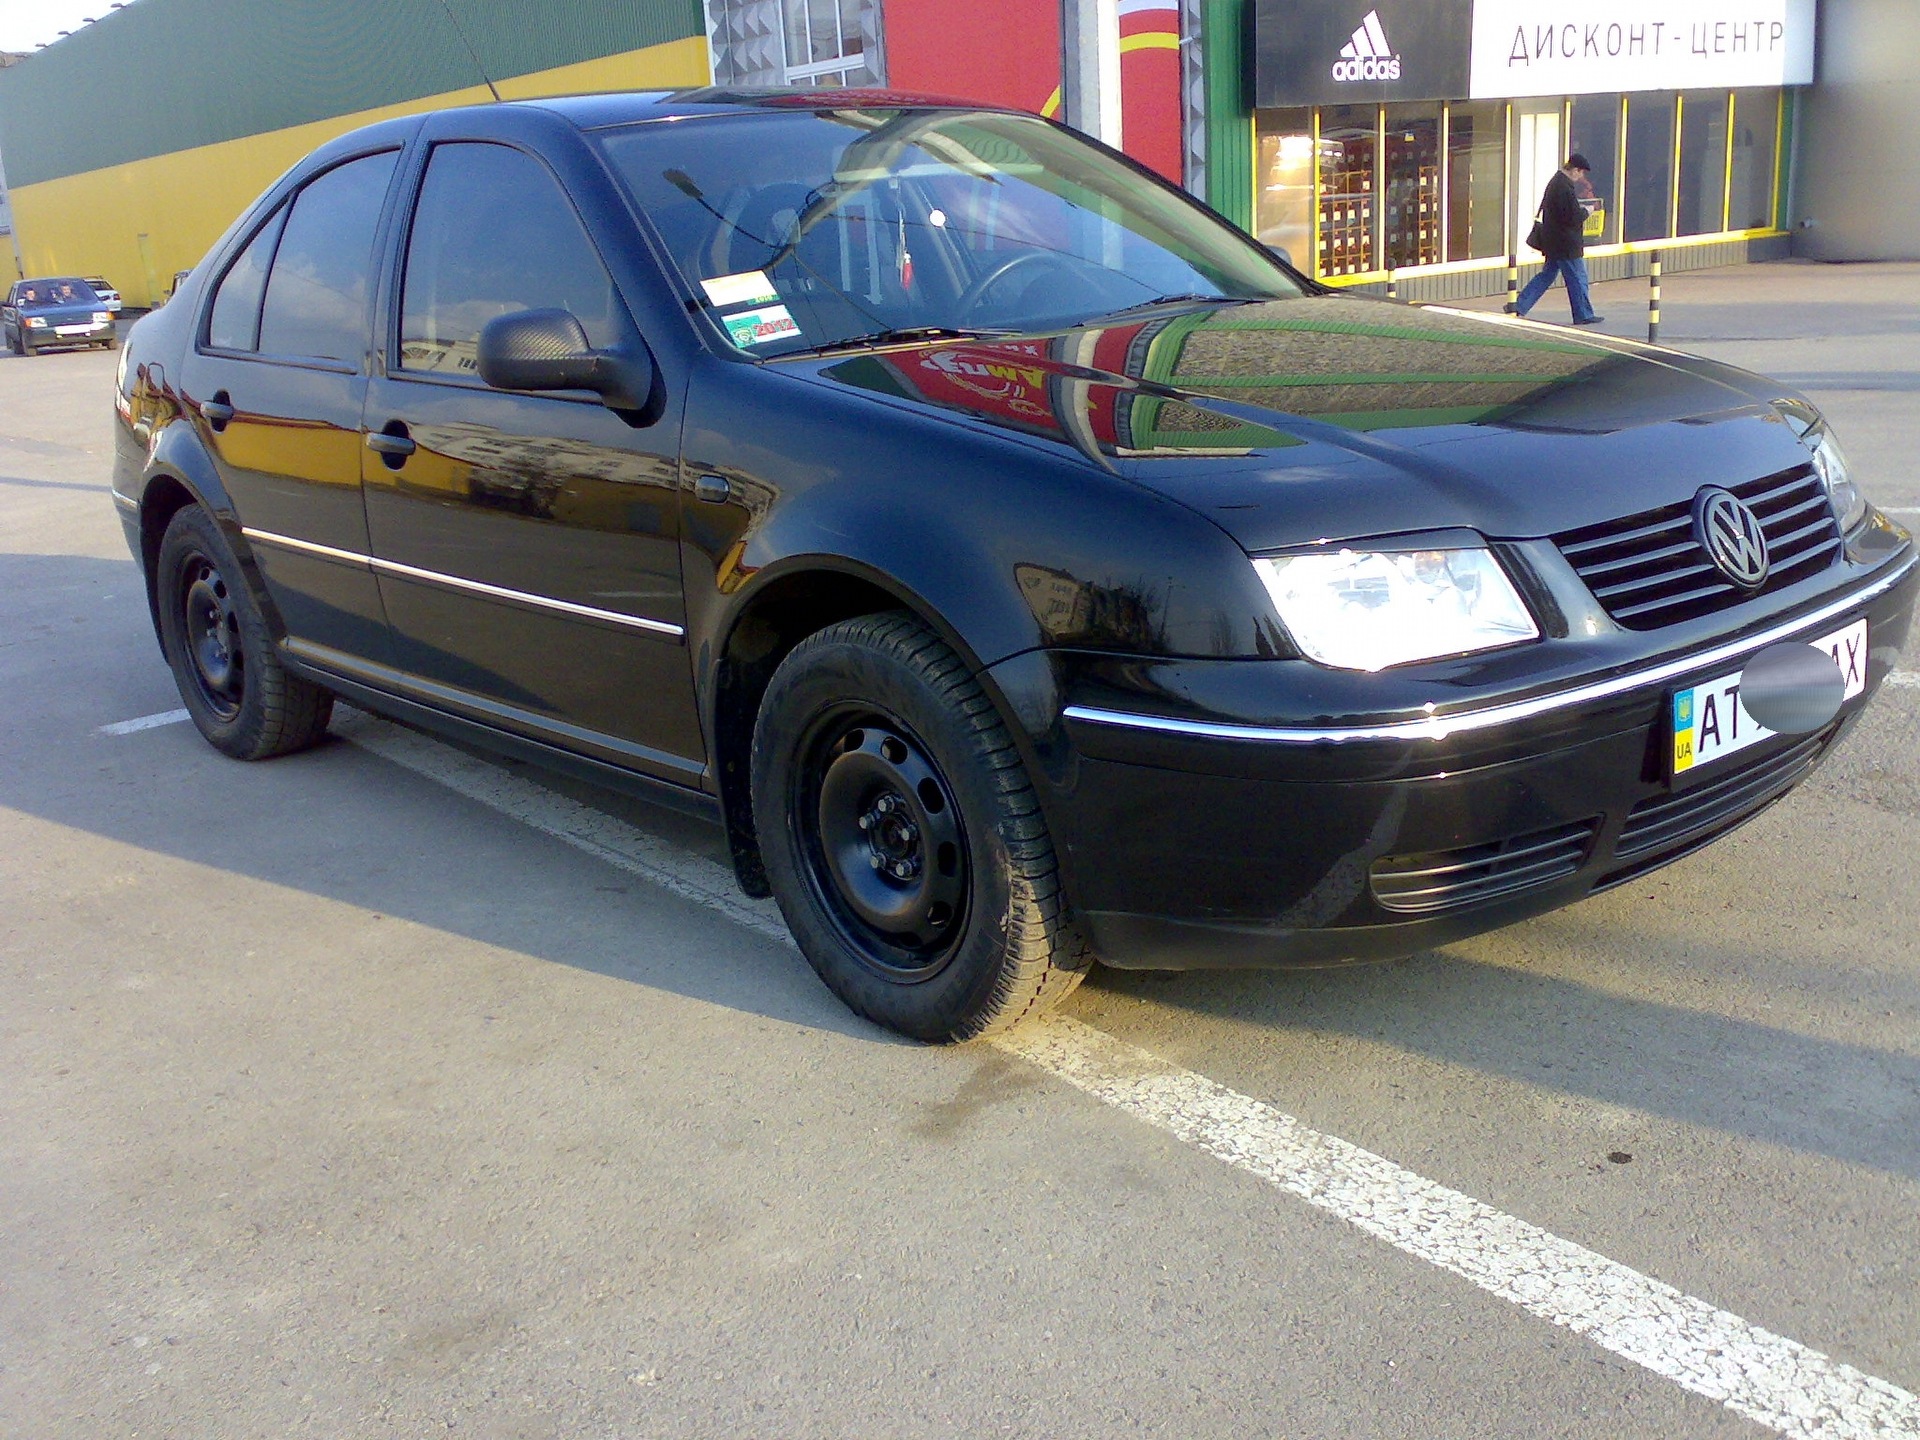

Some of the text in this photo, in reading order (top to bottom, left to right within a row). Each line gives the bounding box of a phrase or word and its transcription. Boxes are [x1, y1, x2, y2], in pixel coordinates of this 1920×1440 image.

[1509, 21, 1784, 67] ДИСКОНТ-ЦЕНТР
[1331, 55, 1401, 82] adidas
[1677, 744, 1692, 760] UA
